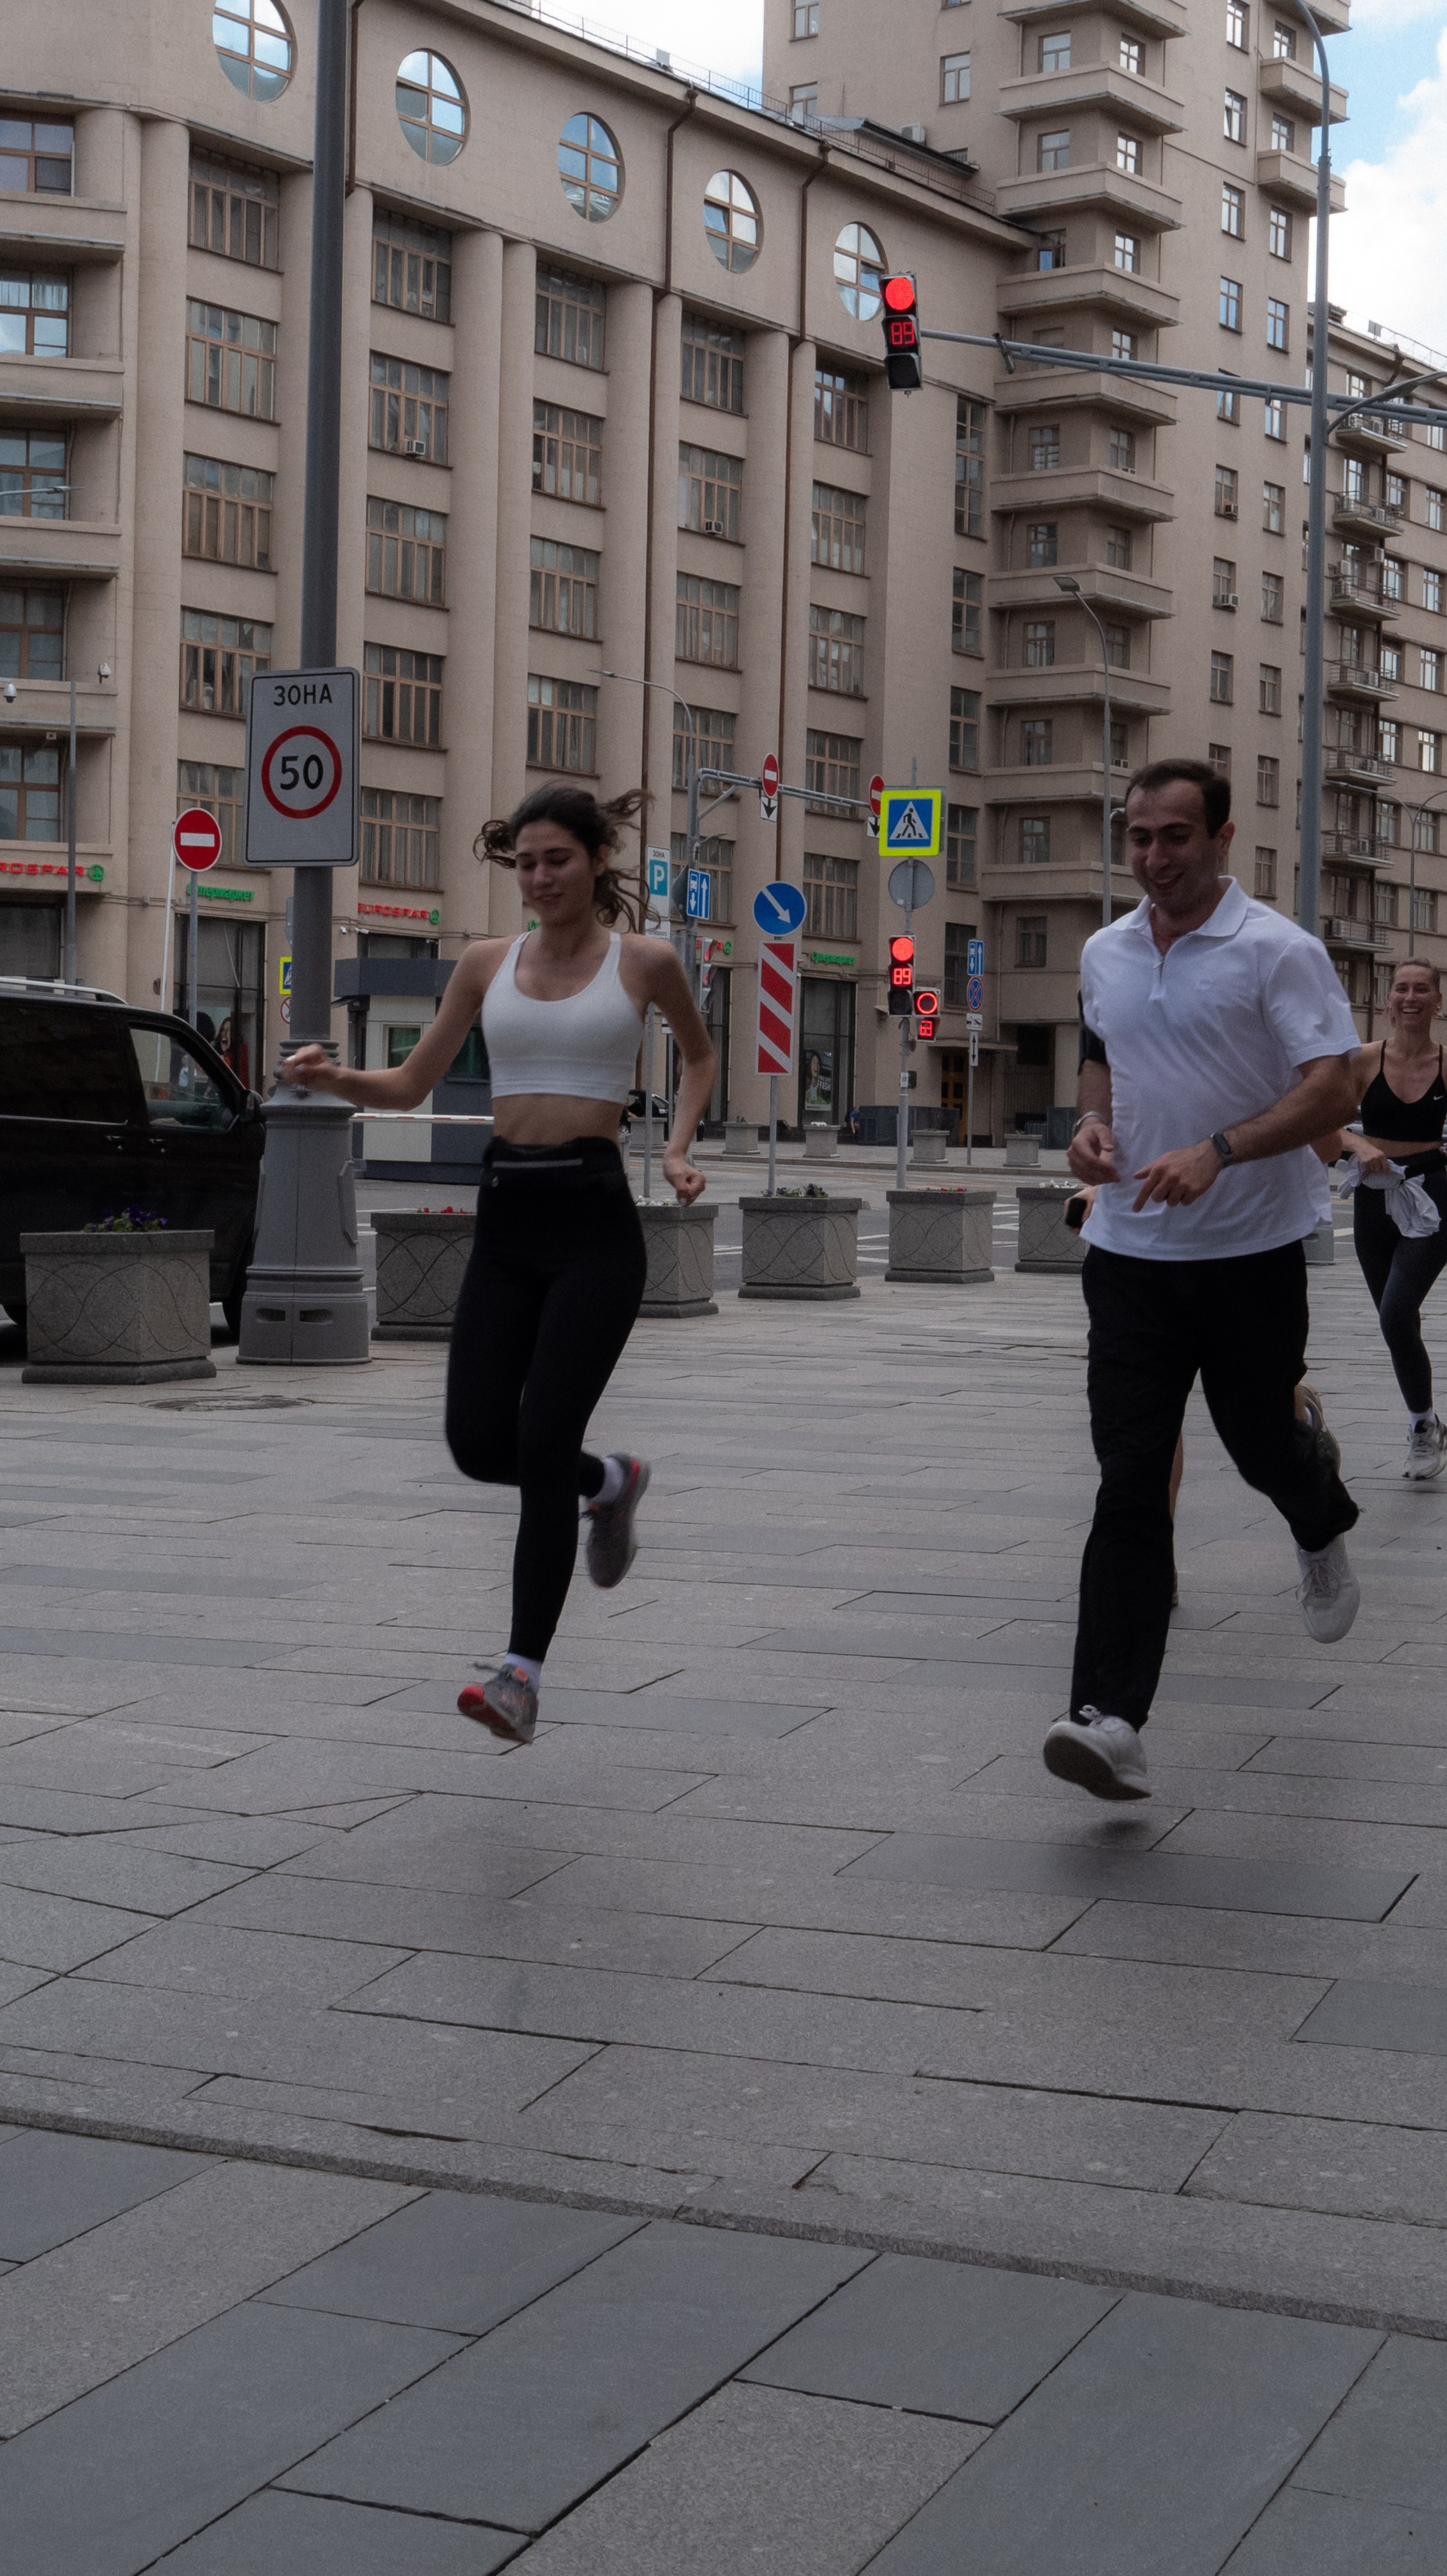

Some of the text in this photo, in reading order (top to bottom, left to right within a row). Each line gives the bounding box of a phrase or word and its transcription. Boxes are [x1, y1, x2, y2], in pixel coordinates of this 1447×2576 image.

[891, 322, 915, 344] 89
[274, 684, 332, 706] ЗОНА
[280, 754, 323, 790] 50
[653, 850, 665, 858] ЗОНА
[654, 865, 664, 890] P
[357, 901, 428, 919] EUROSPAR
[893, 968, 911, 985] 89
